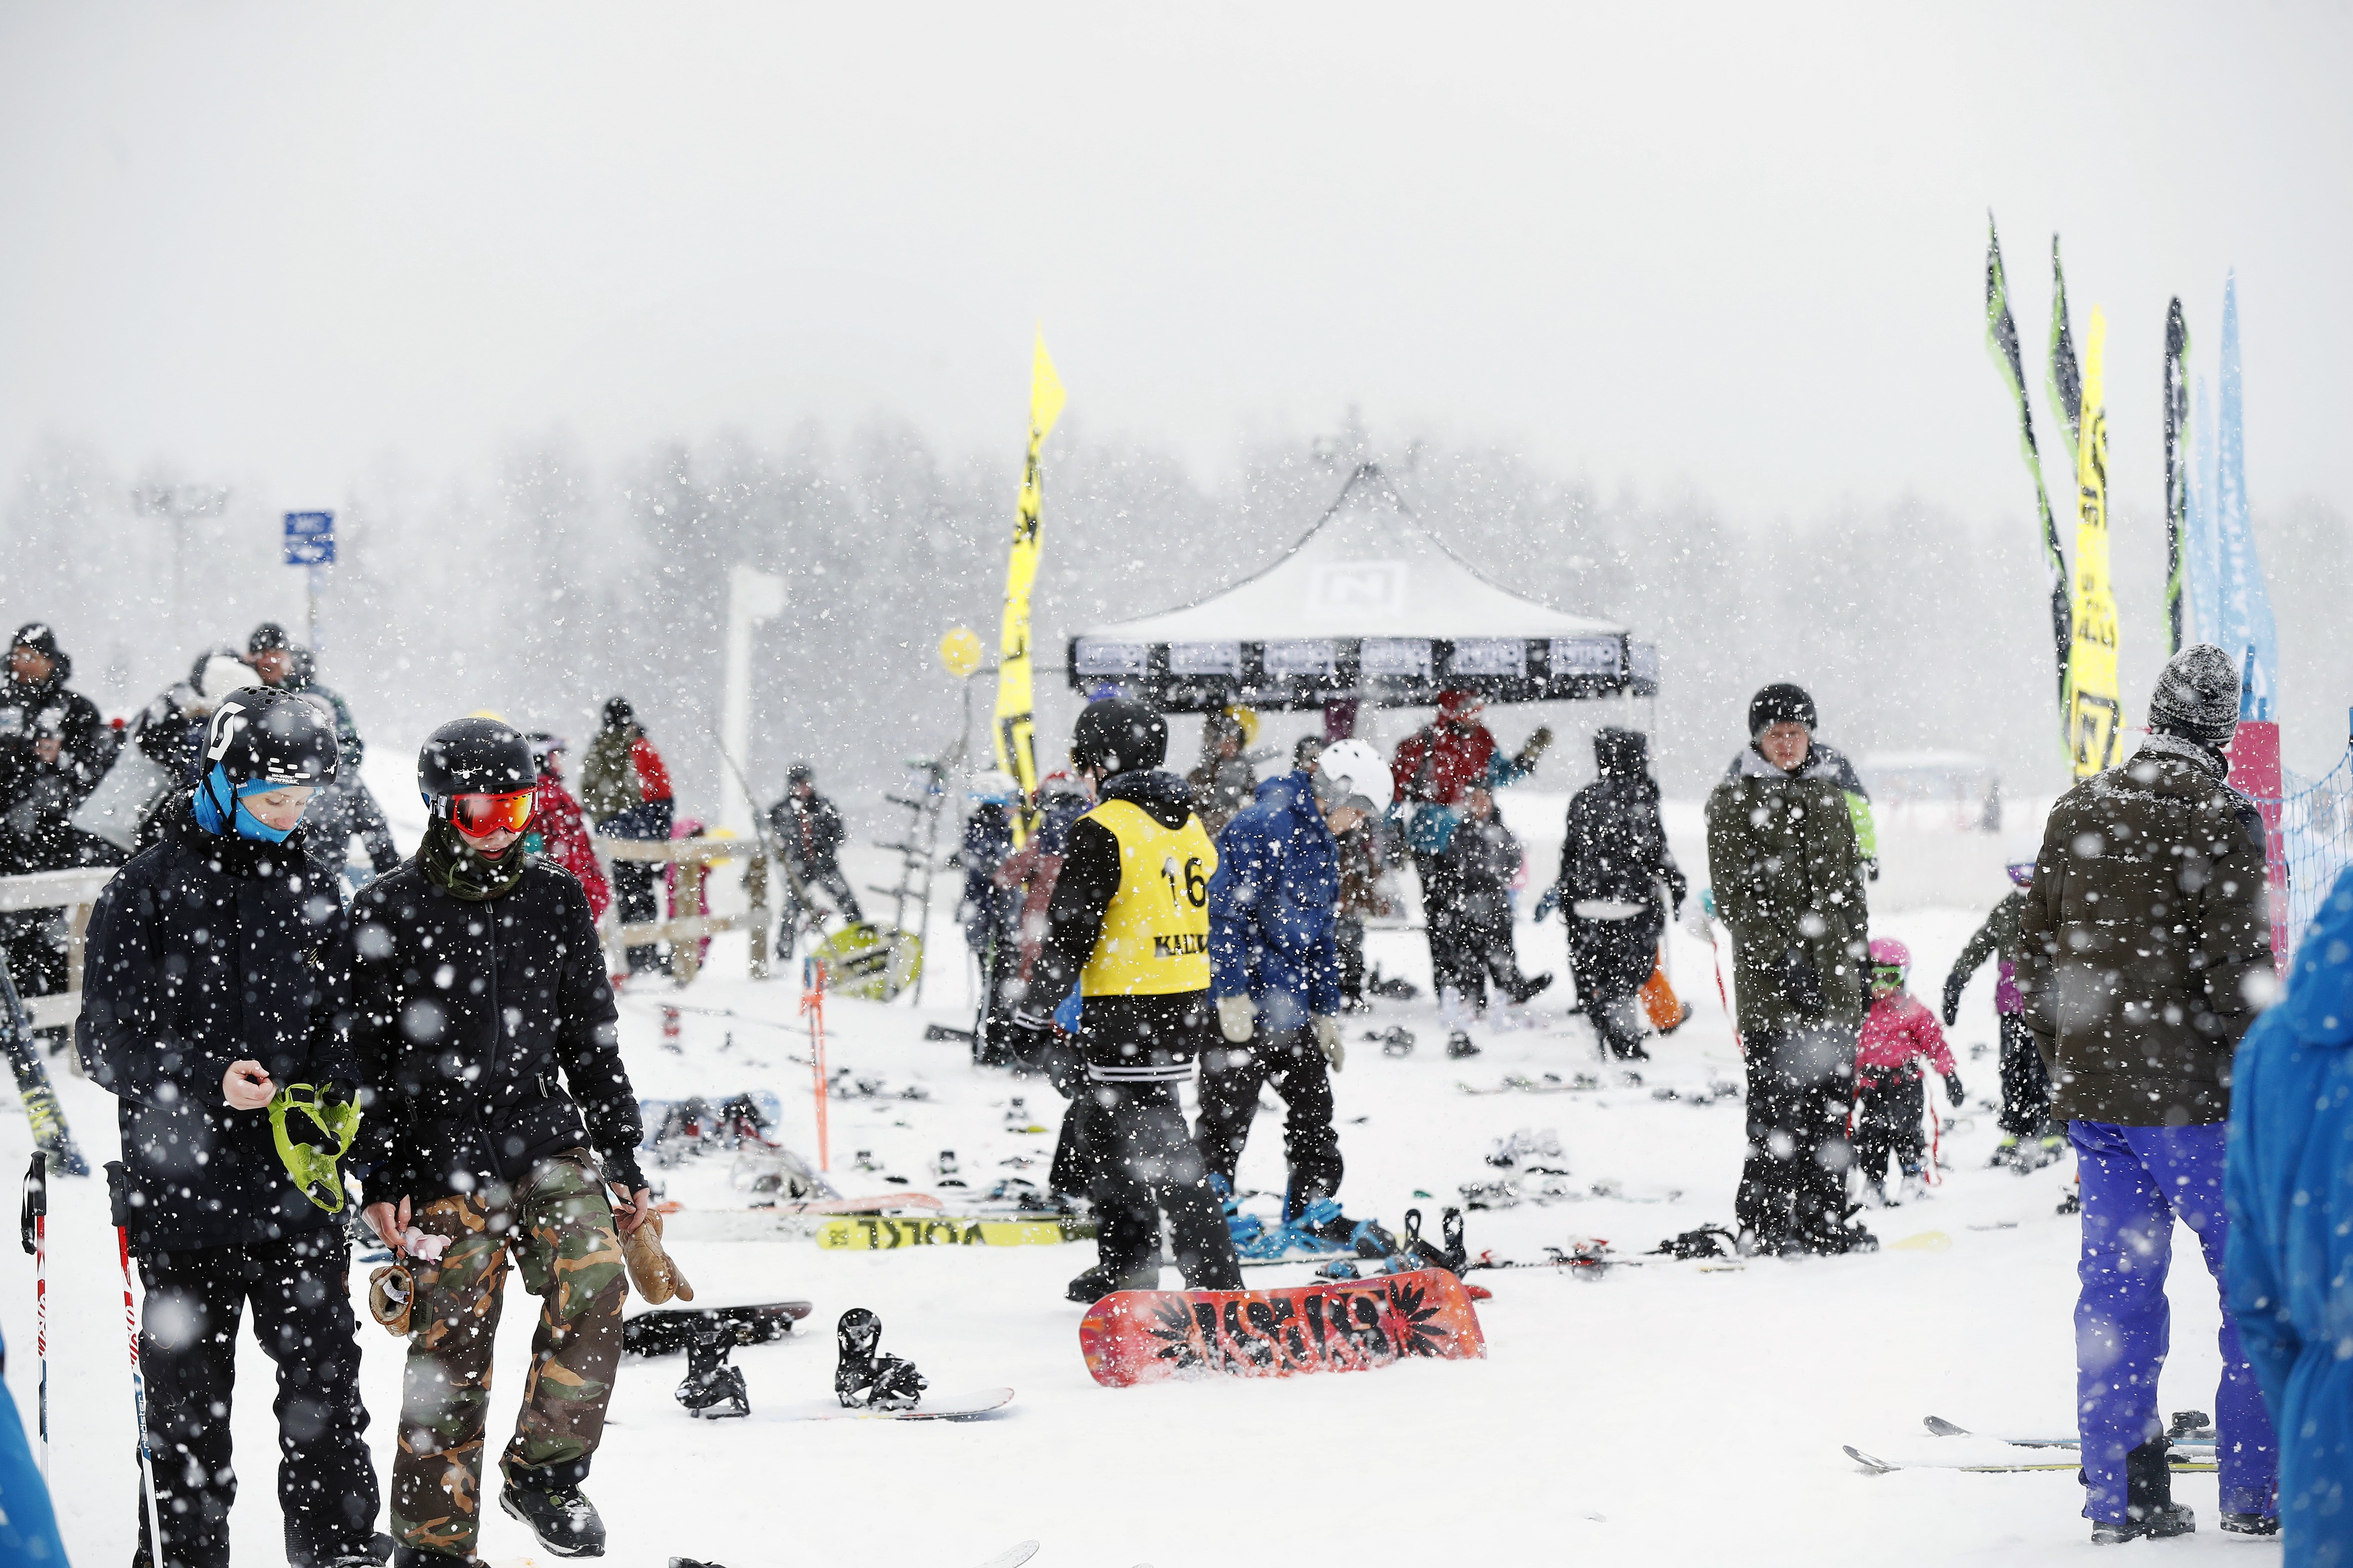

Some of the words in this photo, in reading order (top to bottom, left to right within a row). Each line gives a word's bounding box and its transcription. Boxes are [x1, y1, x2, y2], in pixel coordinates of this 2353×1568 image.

[265, 776, 298, 784] SNOWPARK
[1161, 857, 1206, 908] 16
[138, 1394, 149, 1449] redster
